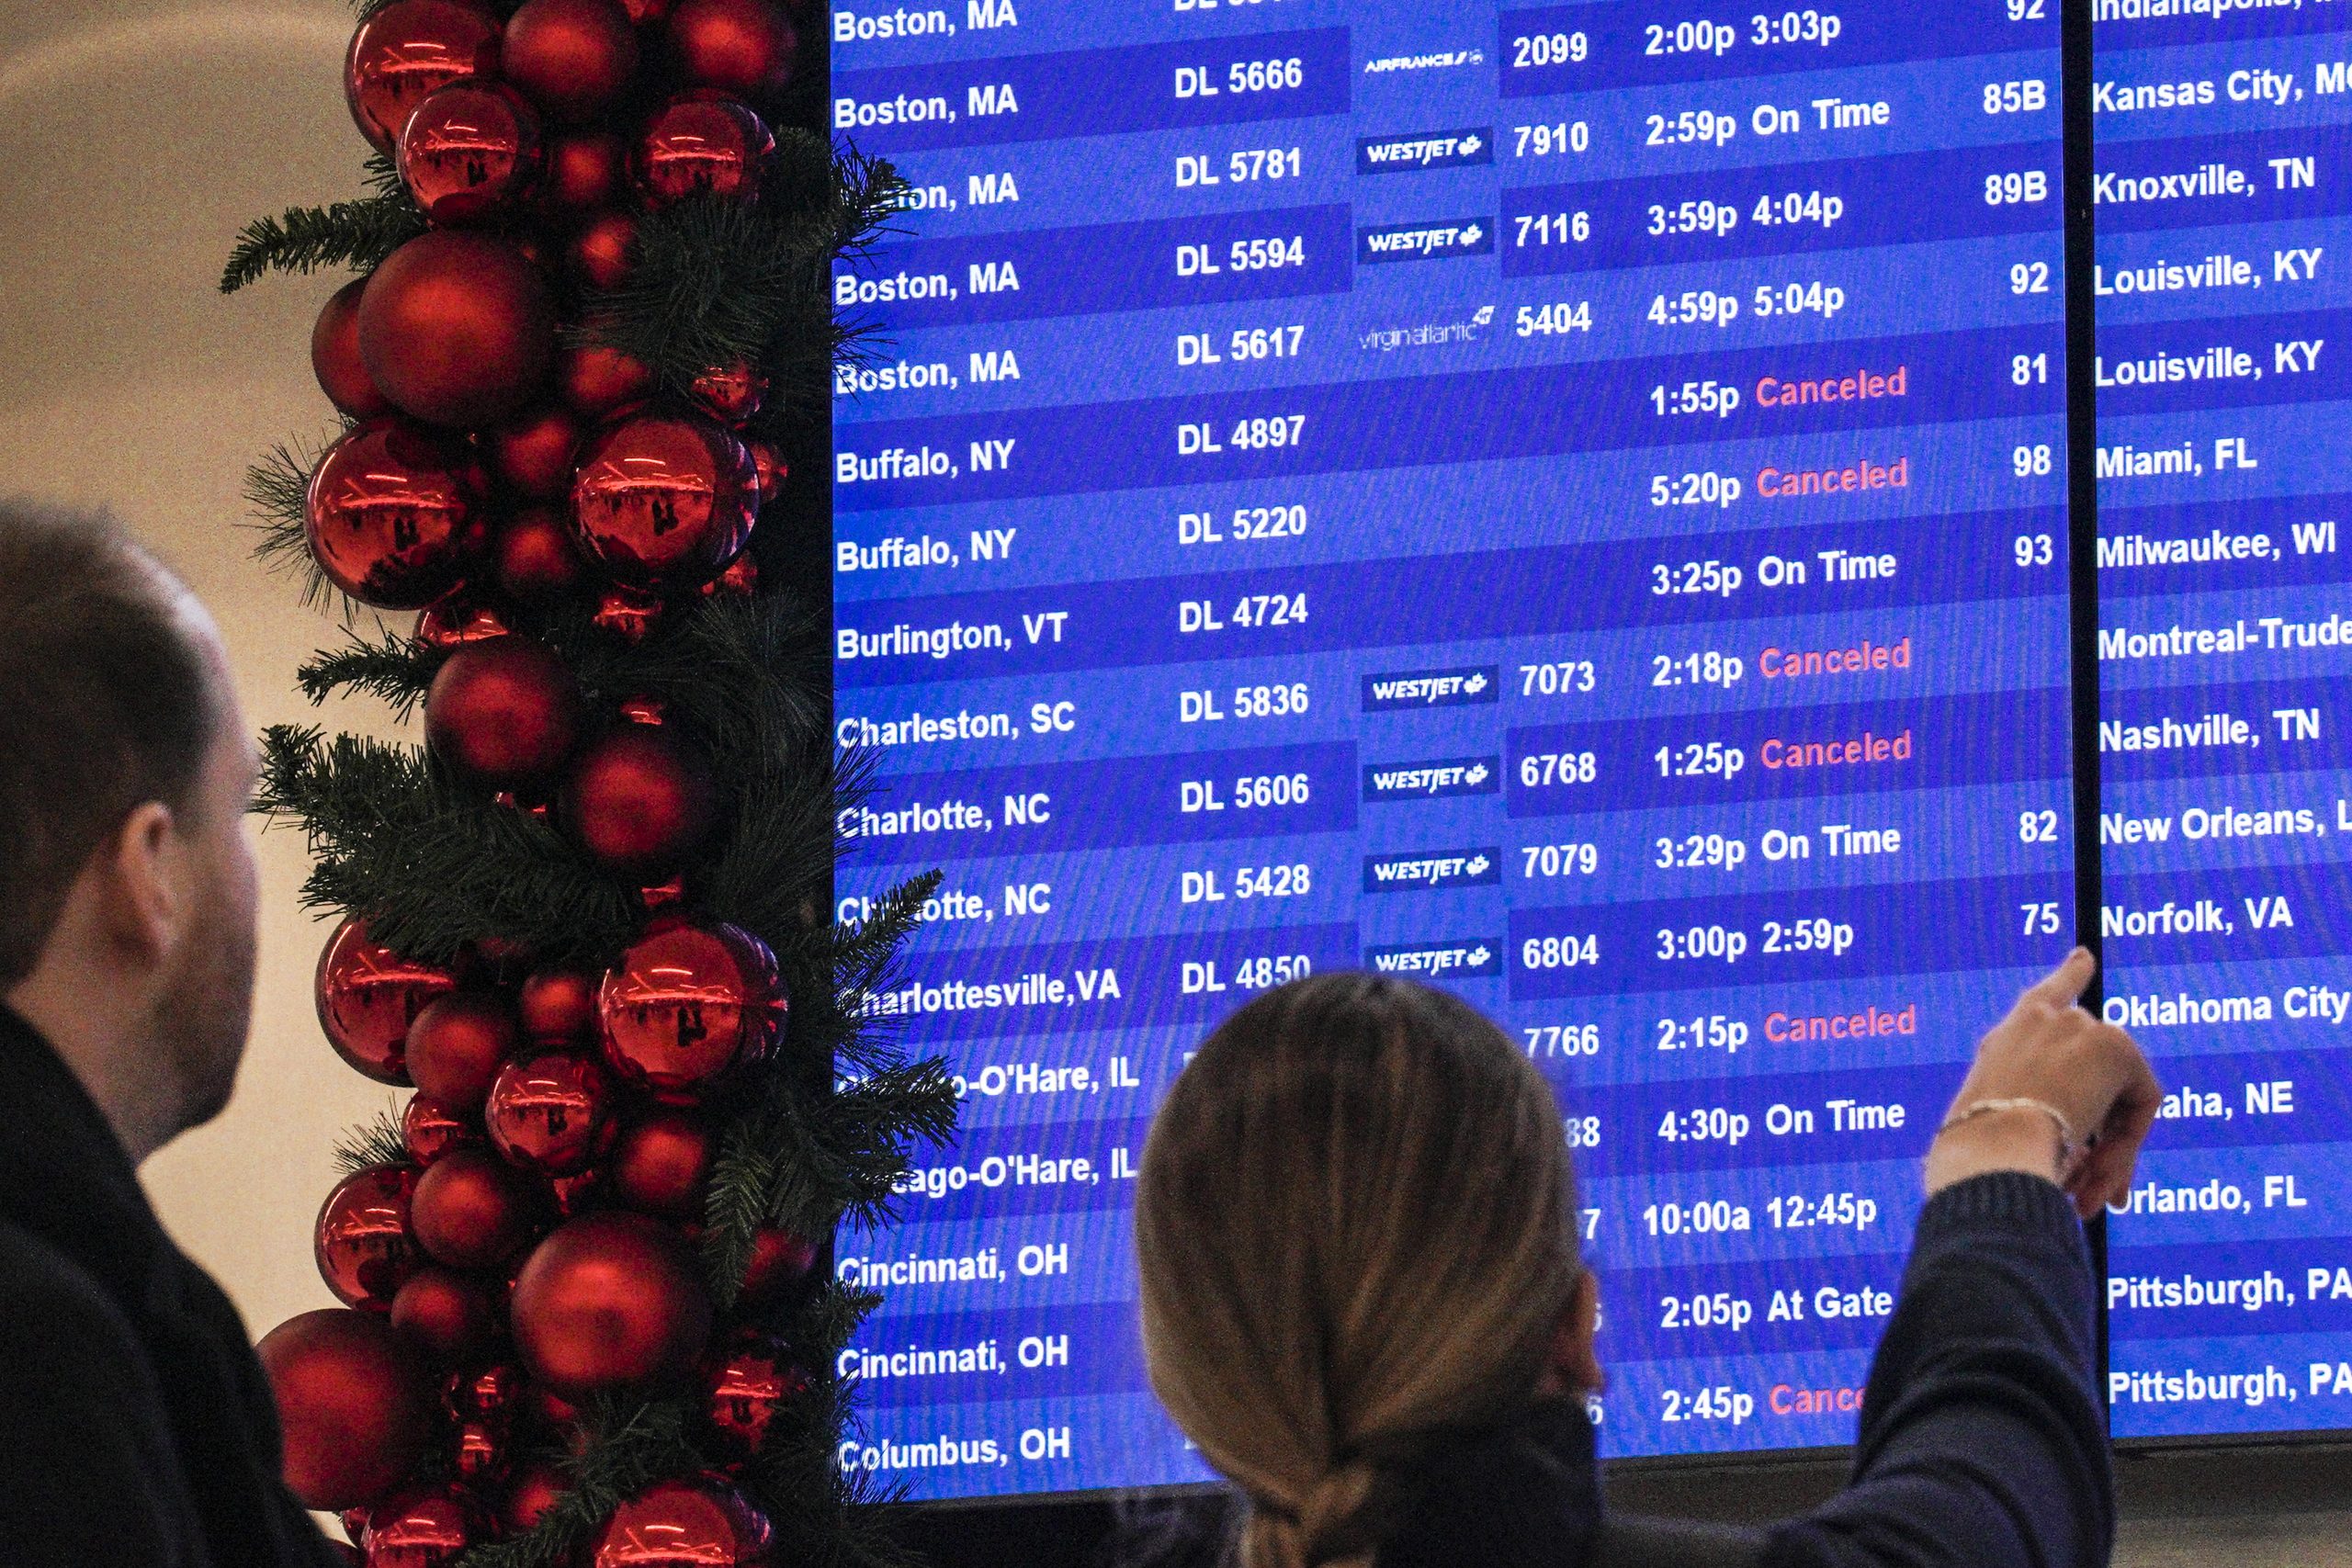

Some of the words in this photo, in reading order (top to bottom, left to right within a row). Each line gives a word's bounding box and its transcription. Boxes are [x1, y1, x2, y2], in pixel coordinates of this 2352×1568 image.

[835, 8, 955, 41] Boston,
[968, 0, 1017, 29] MA
[2007, 0, 2044, 20] 92
[1514, 32, 1587, 67] 2099
[1646, 20, 1735, 55] 2:00p
[1752, 10, 1840, 46] 3:03p
[1176, 67, 1218, 97] DL
[1230, 58, 1302, 93] 5666
[1984, 80, 2045, 114] 85B
[2094, 81, 2215, 112] Kansas
[2228, 70, 2302, 105] City,
[2316, 62, 2352, 94] M
[835, 95, 955, 128] Boston,
[969, 85, 1018, 116] MA
[1646, 110, 1736, 146] 2:59p
[1752, 105, 1799, 135] On
[1812, 98, 1890, 130] Time
[1367, 139, 1459, 165] WESTJET
[1514, 121, 1589, 157] 7910
[1176, 155, 1219, 187] DL
[1230, 147, 1300, 182] 5781
[1985, 171, 2047, 205] 89B
[2094, 164, 2254, 204] Knoxville,
[2268, 157, 2314, 189] TN
[969, 173, 1019, 205] MA
[1368, 228, 1460, 255] WESTJET
[1515, 212, 1589, 246] 7116
[1648, 201, 1737, 236] 3:59p
[1753, 191, 1843, 227] 4:04p
[1177, 244, 1219, 276] DL
[1231, 236, 1305, 271] 5594
[2095, 255, 2261, 295] Louisville,
[2275, 248, 2323, 281] KY
[836, 272, 956, 305] Boston,
[970, 262, 1019, 293] MA
[2011, 262, 2048, 294] 92
[1517, 301, 1592, 336] 5404
[1647, 291, 1738, 327] 4:59p
[1755, 282, 1844, 318] 5:04p
[1178, 333, 1220, 366] DL
[1232, 325, 1304, 360] 5617
[2096, 347, 2262, 386] Louisville,
[2276, 340, 2324, 373] KY
[837, 361, 957, 393] Boston,
[970, 350, 1020, 382] MA
[2012, 354, 2046, 385] 81
[1652, 381, 1739, 417] 1:55p
[1757, 367, 1905, 407] Canceled
[1179, 423, 1221, 455] DL
[1231, 415, 1305, 449] 4897
[837, 447, 957, 482] Buffalo,
[971, 439, 1014, 471] NY
[2014, 445, 2051, 477] 98
[2097, 442, 2202, 478] Miami,
[2216, 438, 2257, 469] FL
[1652, 472, 1741, 508] 5:20p
[1758, 457, 1907, 497] Canceled
[1179, 513, 1222, 544] DL
[1234, 505, 1306, 539] 5220
[2098, 530, 2280, 568] Milwaukee,
[2292, 522, 2335, 554] WI
[838, 536, 958, 570] Buffalo,
[971, 528, 1015, 560] NY
[2016, 535, 2052, 566] 93
[1653, 561, 1742, 597] 3:25p
[1758, 557, 1805, 586] On
[1818, 550, 1896, 581] Time
[1181, 601, 1223, 632] DL
[1233, 593, 1307, 626] 4724
[838, 622, 1011, 659] Burlington,
[1023, 613, 1068, 643] VT
[1373, 677, 1464, 704] WESTJET
[1521, 661, 1595, 695] 7073
[1653, 651, 1743, 688] 2:18p
[1759, 638, 1910, 678] Canceled
[1181, 691, 1224, 722] DL
[1235, 683, 1308, 717] 5836
[838, 710, 1018, 748] Charleston,
[1031, 702, 1075, 733] SC
[2100, 714, 2259, 751] Nashville,
[2273, 708, 2319, 740] TN
[1374, 767, 1465, 794] WESTJET
[1521, 752, 1596, 786] 6768
[1656, 742, 1744, 779] 1:25p
[1761, 730, 1911, 769] Canceled
[1182, 781, 1224, 812] DL
[1236, 774, 1308, 807] 5606
[838, 801, 991, 838] Charlotte,
[1005, 794, 1049, 825] NC
[2020, 810, 2057, 842] 82
[2101, 813, 2172, 844] New
[2182, 807, 2325, 840] Orleans,
[1374, 859, 1465, 885] WESTJET
[1522, 844, 1597, 877] 7079
[1657, 835, 1746, 871] 3:29p
[1761, 829, 1809, 861] On
[1822, 825, 1901, 856] Time
[1005, 884, 1050, 916] NC
[1182, 871, 1225, 903] DL
[1236, 864, 1310, 898] 5428
[2021, 903, 2059, 935] 75
[2102, 900, 2233, 937] Norfolk,
[2245, 897, 2293, 929] VA
[1375, 950, 1467, 976] WESTJET
[1523, 935, 1599, 968] 6804
[1657, 926, 1747, 963] 3:00p
[1763, 919, 1853, 955] 2:59p
[1182, 962, 1226, 993] DL
[1236, 954, 1311, 989] 4850
[1658, 1016, 1748, 1053] 2:15p
[1765, 1004, 1916, 1043] Canceled
[2102, 992, 2272, 1028] Oklahoma
[1523, 1024, 1600, 1058] 7766
[1110, 1056, 1139, 1087] IL
[2246, 1081, 2293, 1113] NE
[1658, 1108, 1748, 1145] 4:30p
[1766, 1104, 1813, 1134] On
[1826, 1100, 1905, 1131] Time
[1112, 1148, 1138, 1179] IL
[2265, 1176, 2307, 1207] FL
[1644, 1201, 1749, 1235] 10:00a
[1767, 1193, 1876, 1231] 12:45p
[838, 1247, 1005, 1287] Cincinnati,
[1018, 1243, 1068, 1276] OH
[1662, 1293, 1751, 1331] 2:05p
[1768, 1291, 1804, 1321] At
[1815, 1287, 1892, 1318] Gate
[2109, 1271, 2294, 1310] Pittsburgh,
[2309, 1268, 2352, 1300] PA
[839, 1340, 1005, 1379] Cincinnati,
[1019, 1335, 1068, 1367] OH
[2109, 1366, 2296, 1405] Pittsburgh,
[2311, 1363, 2352, 1394] PA
[1662, 1386, 1753, 1425] 2:45p
[839, 1436, 1007, 1472] Columbus,
[1021, 1427, 1069, 1460] OH
